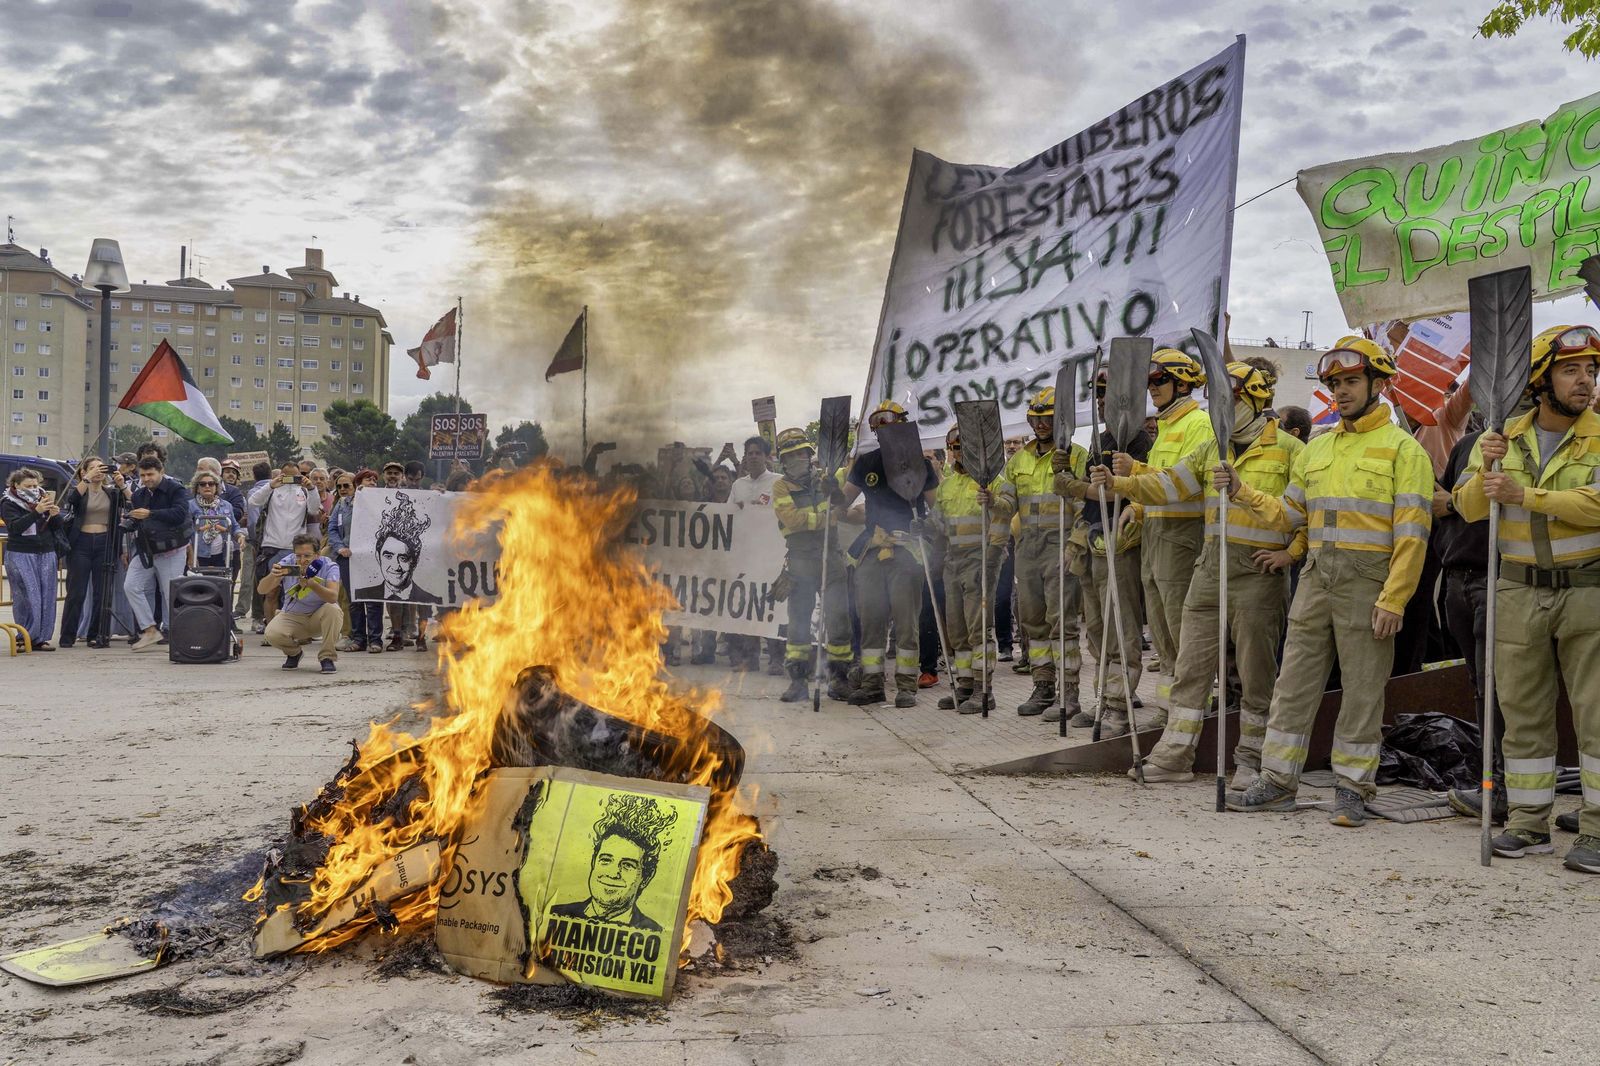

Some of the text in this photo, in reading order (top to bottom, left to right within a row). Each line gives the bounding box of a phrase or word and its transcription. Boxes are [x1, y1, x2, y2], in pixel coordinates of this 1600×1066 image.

[434, 418, 457, 431] SOS
[460, 417, 483, 431] SOS
[396, 862, 409, 888] Smart
[459, 918, 500, 935] Packaging
[544, 917, 662, 963] MAÑUECO
[629, 959, 657, 985] YA!
